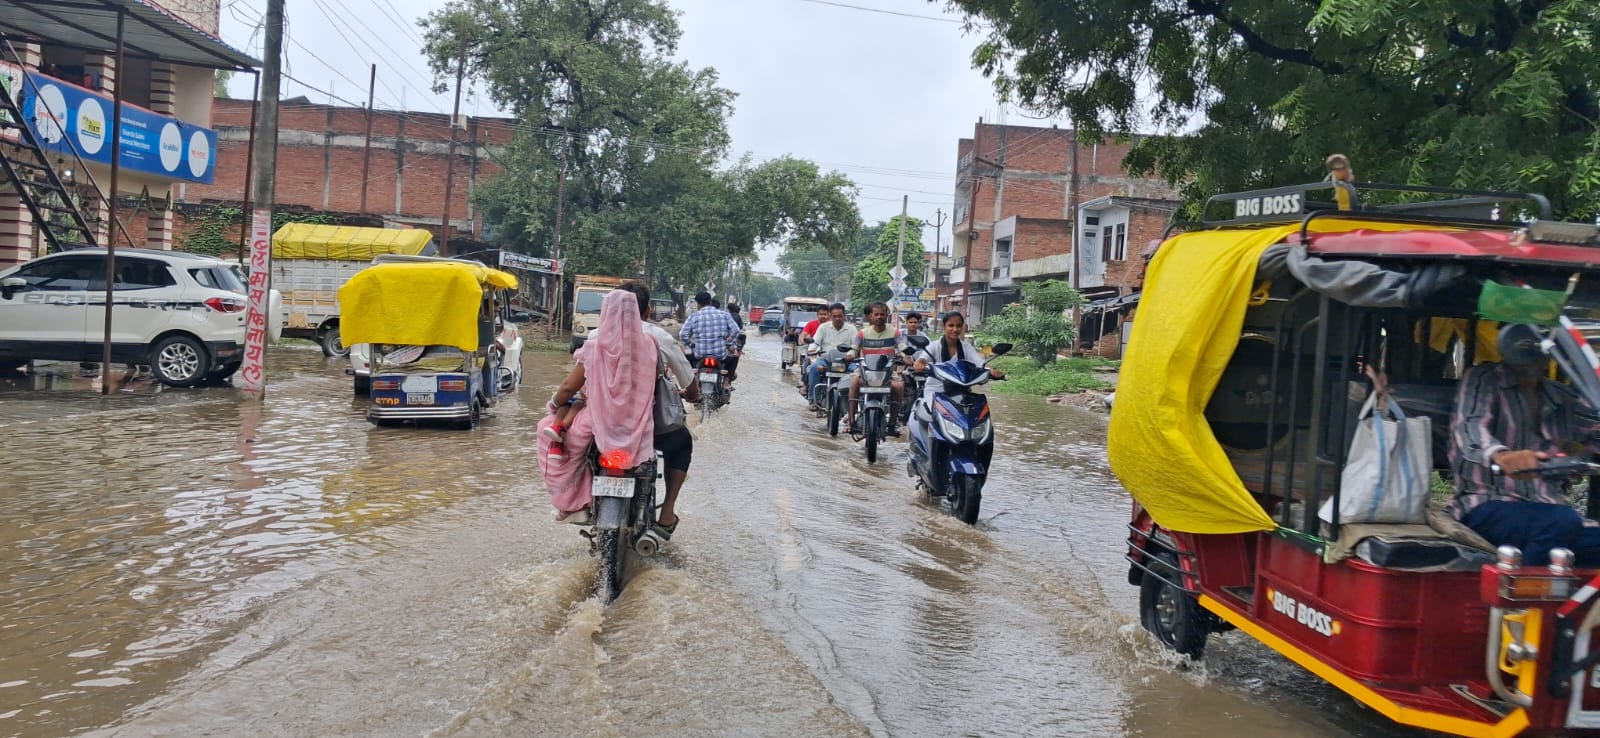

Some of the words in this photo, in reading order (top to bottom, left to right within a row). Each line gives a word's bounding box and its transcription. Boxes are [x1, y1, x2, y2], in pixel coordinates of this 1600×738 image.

[1236, 198, 1260, 217] BIG
[1262, 194, 1300, 215] BOSS
[375, 397, 400, 406] STOP
[1273, 590, 1296, 620] BIG
[1296, 602, 1333, 638] BOSS
